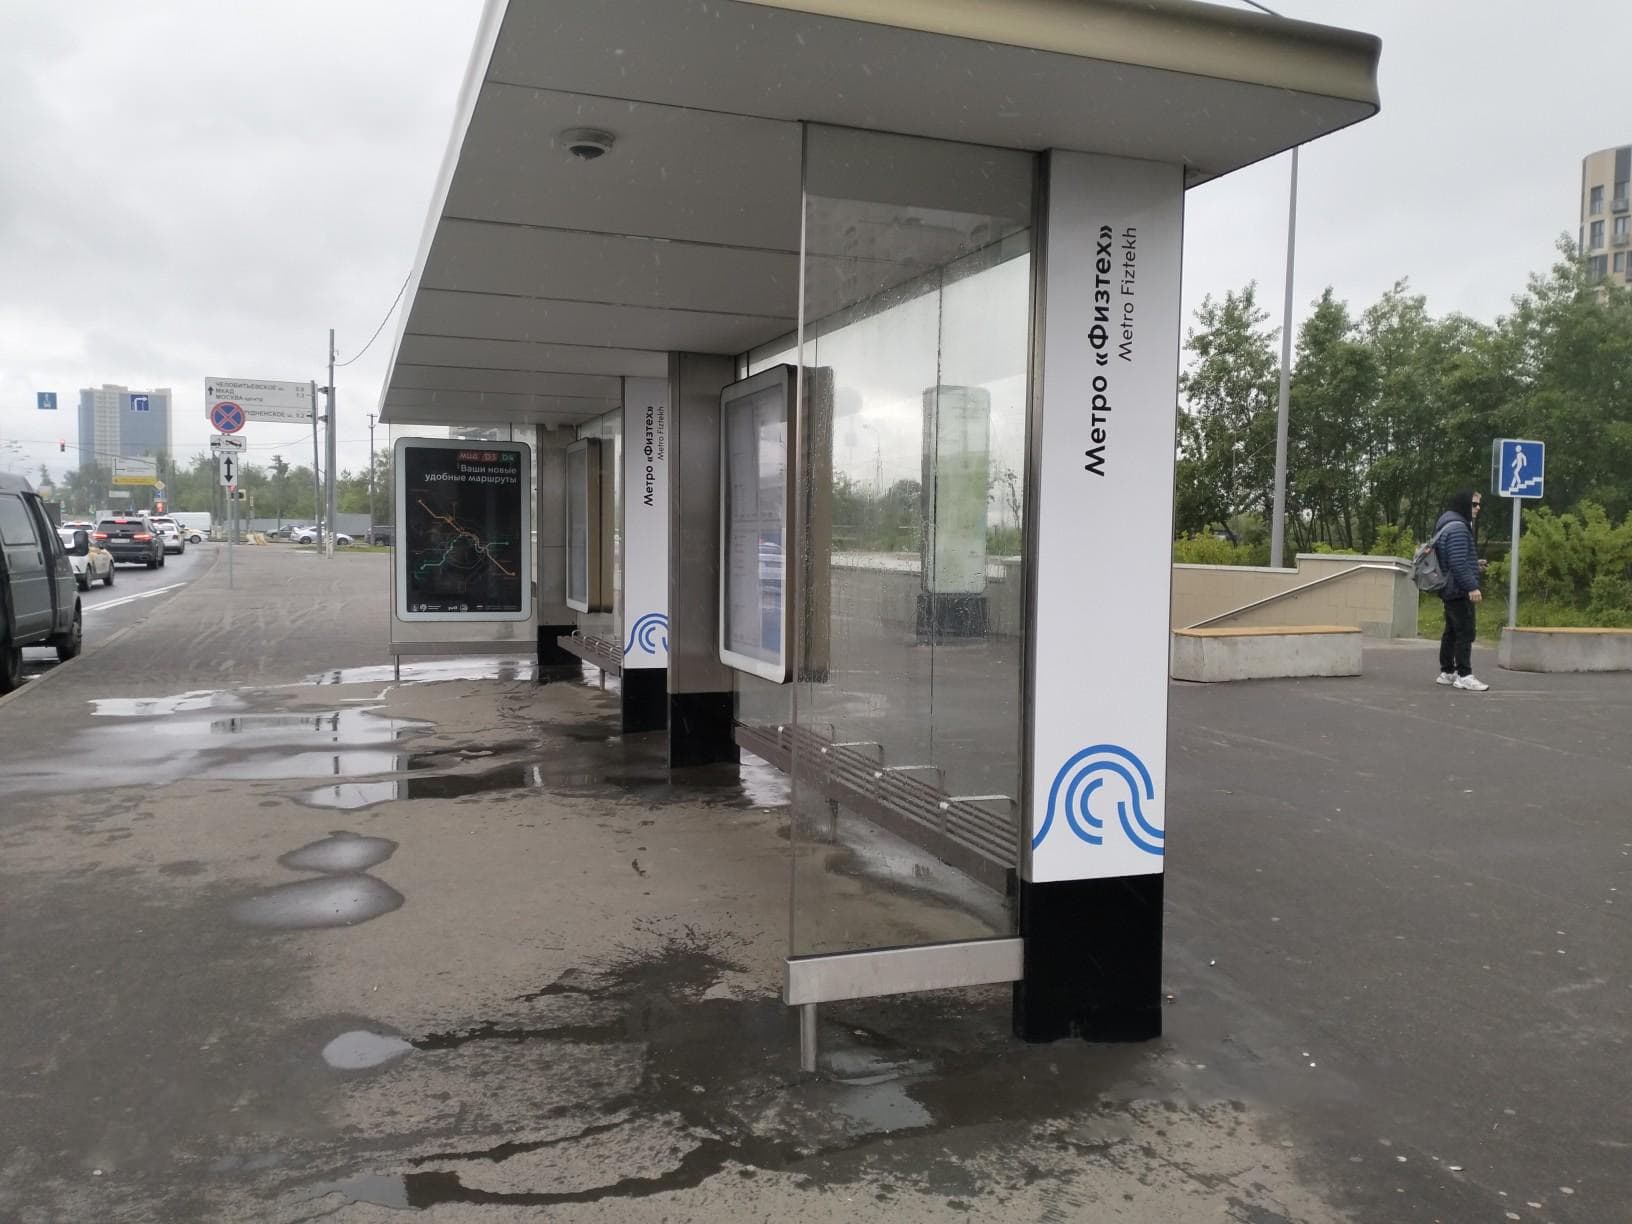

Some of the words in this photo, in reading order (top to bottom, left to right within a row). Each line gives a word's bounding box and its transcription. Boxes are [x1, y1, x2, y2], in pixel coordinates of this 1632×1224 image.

[1120, 227, 1137, 295] Fiztekh
[1087, 224, 1113, 367] «Физтех»
[1118, 301, 1134, 362] Metro
[643, 406, 654, 463] «Физтех»
[657, 436, 665, 461] Metro
[1084, 375, 1111, 477] Метро
[424, 472, 466, 482] удобные
[468, 475, 517, 485] маршруты
[460, 464, 486, 473] Ваши
[488, 466, 517, 474] новые
[643, 465, 655, 506] Метро
